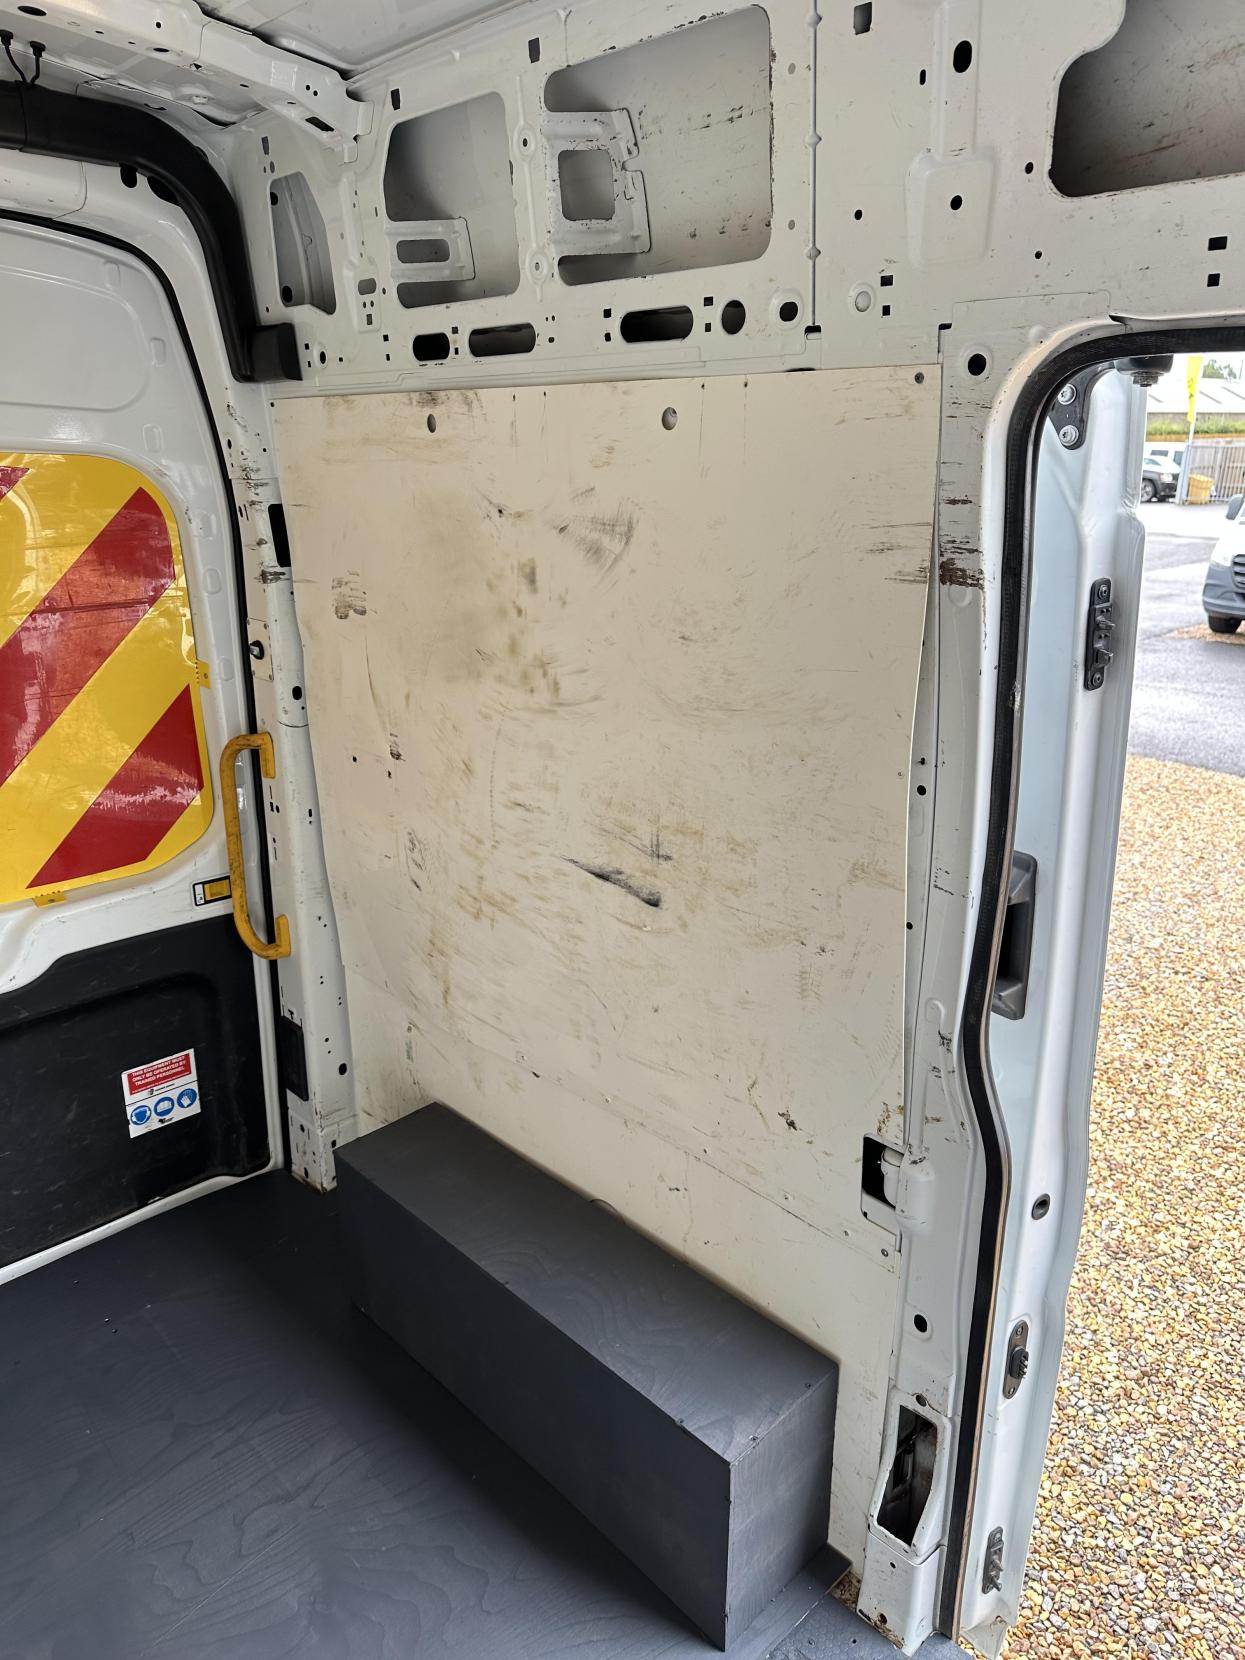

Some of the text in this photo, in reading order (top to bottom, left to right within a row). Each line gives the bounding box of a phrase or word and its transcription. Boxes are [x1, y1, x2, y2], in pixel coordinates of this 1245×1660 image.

[132, 1074, 145, 1082] ONLY
[153, 1063, 179, 1075] OPERATED
[135, 1075, 156, 1086] TRAINED
[157, 1066, 185, 1079] PERSONNEL
[144, 1061, 171, 1073] EQUIPMENT
